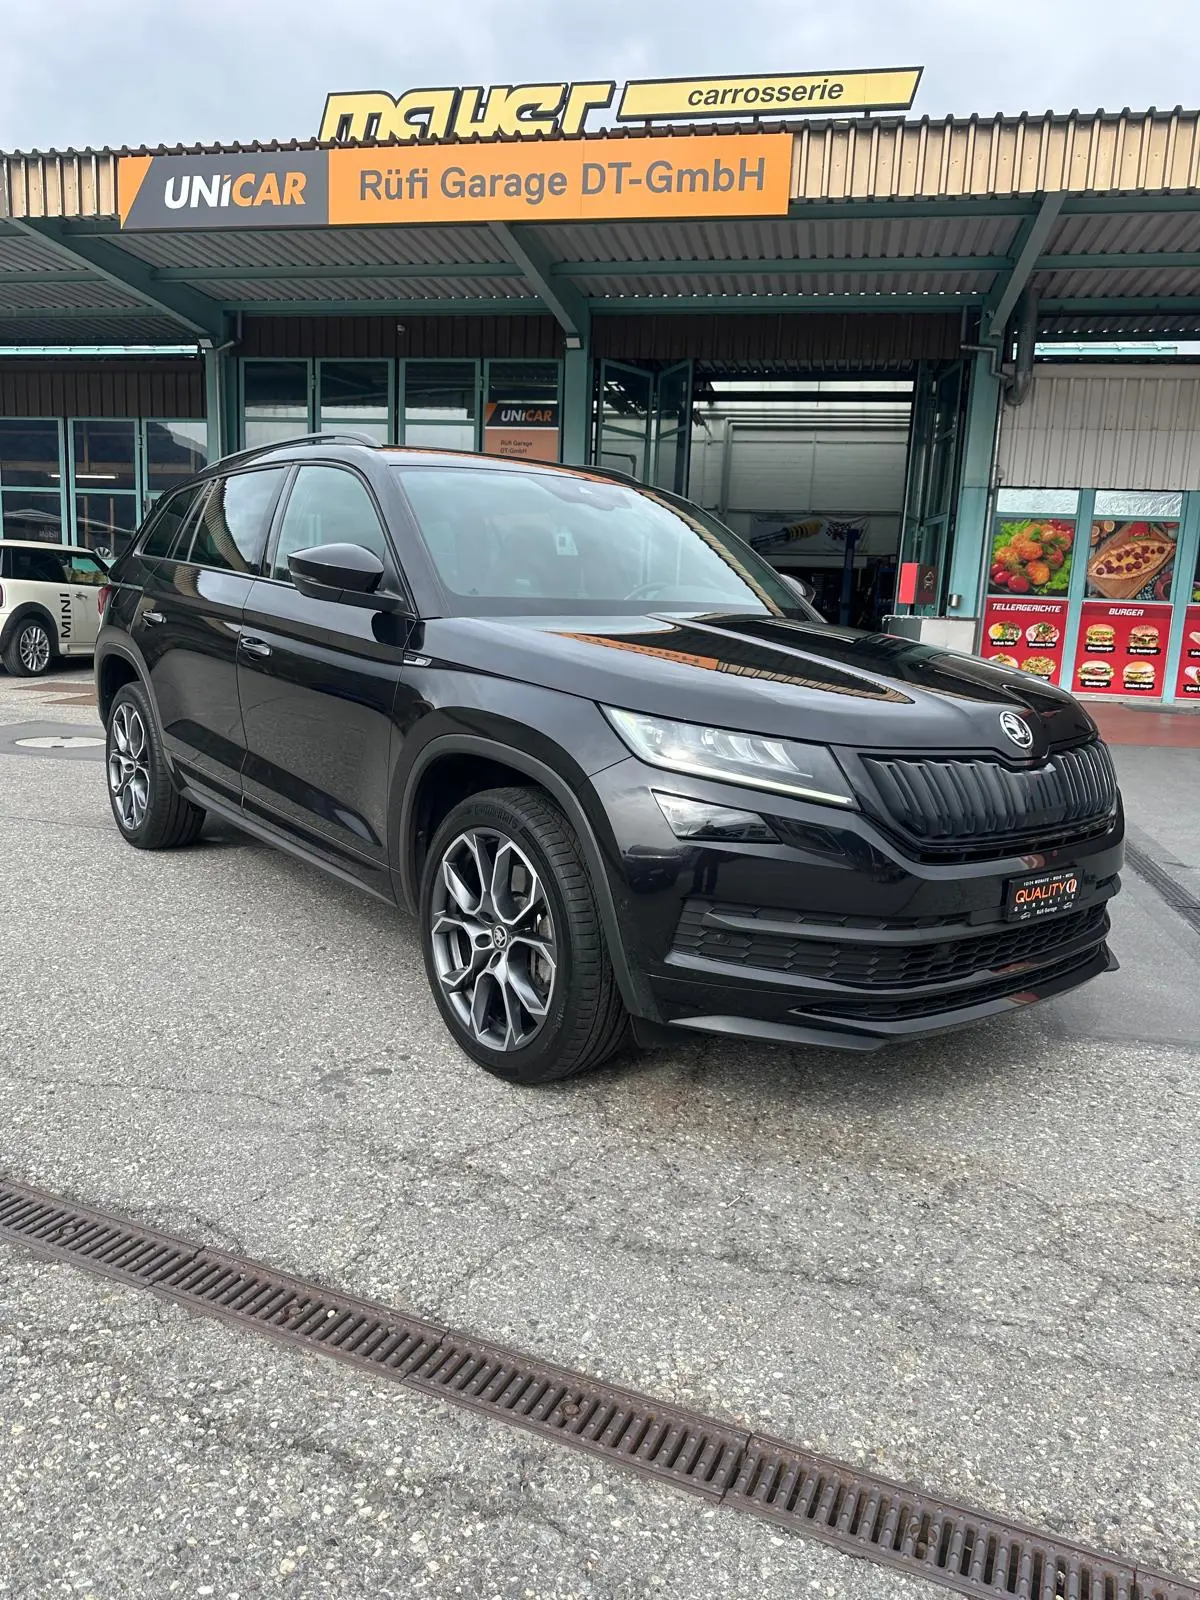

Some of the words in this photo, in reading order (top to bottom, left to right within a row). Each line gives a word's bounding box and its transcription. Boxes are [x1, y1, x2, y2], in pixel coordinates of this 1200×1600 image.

[687, 78, 845, 107] carrosserie
[359, 167, 429, 201] Rüfi
[439, 164, 568, 206] Garage
[580, 156, 767, 196] DT-GmbH
[59, 592, 72, 639] MINI
[992, 602, 1062, 613] TELLERGERICHTE
[1108, 607, 1144, 617] BURGER
